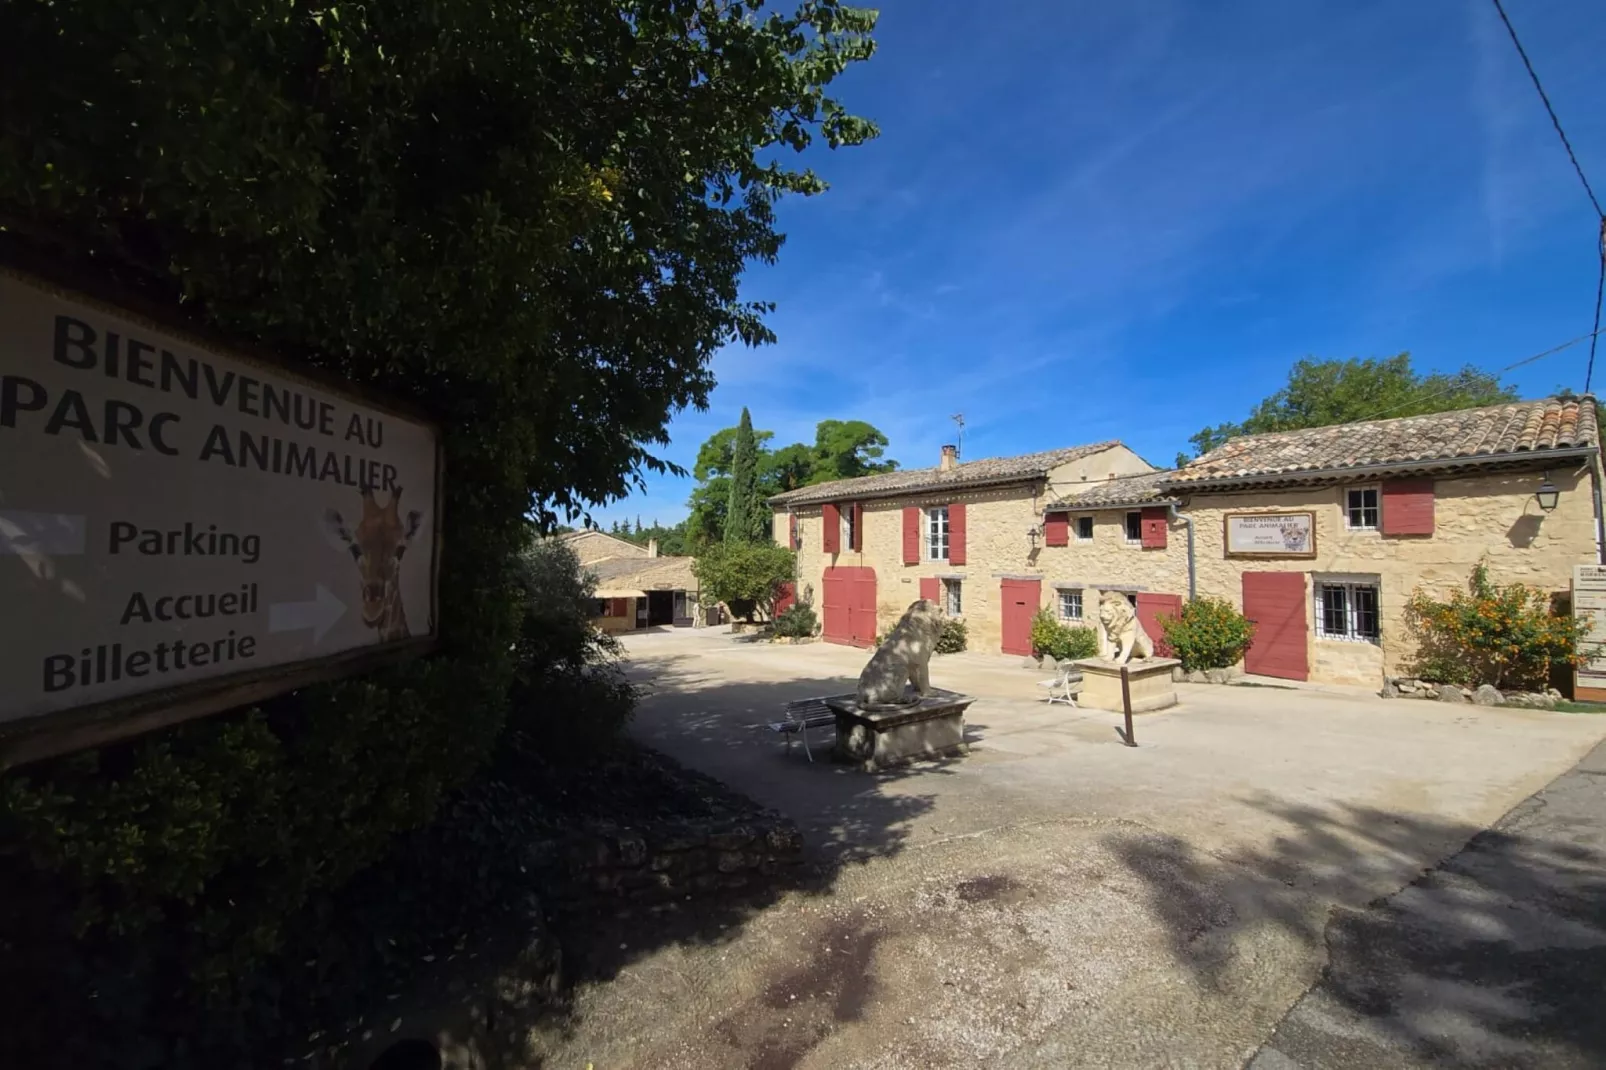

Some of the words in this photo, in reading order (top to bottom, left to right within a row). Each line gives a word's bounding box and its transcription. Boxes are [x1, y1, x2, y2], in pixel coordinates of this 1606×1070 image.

[53, 314, 335, 436] BIENVENUE
[344, 412, 384, 449] AU
[0, 375, 181, 456] PARC
[199, 424, 398, 492] ANIMALIER
[109, 521, 261, 564] Parking
[120, 583, 259, 626] Accueil
[43, 631, 257, 693] Billetterie
